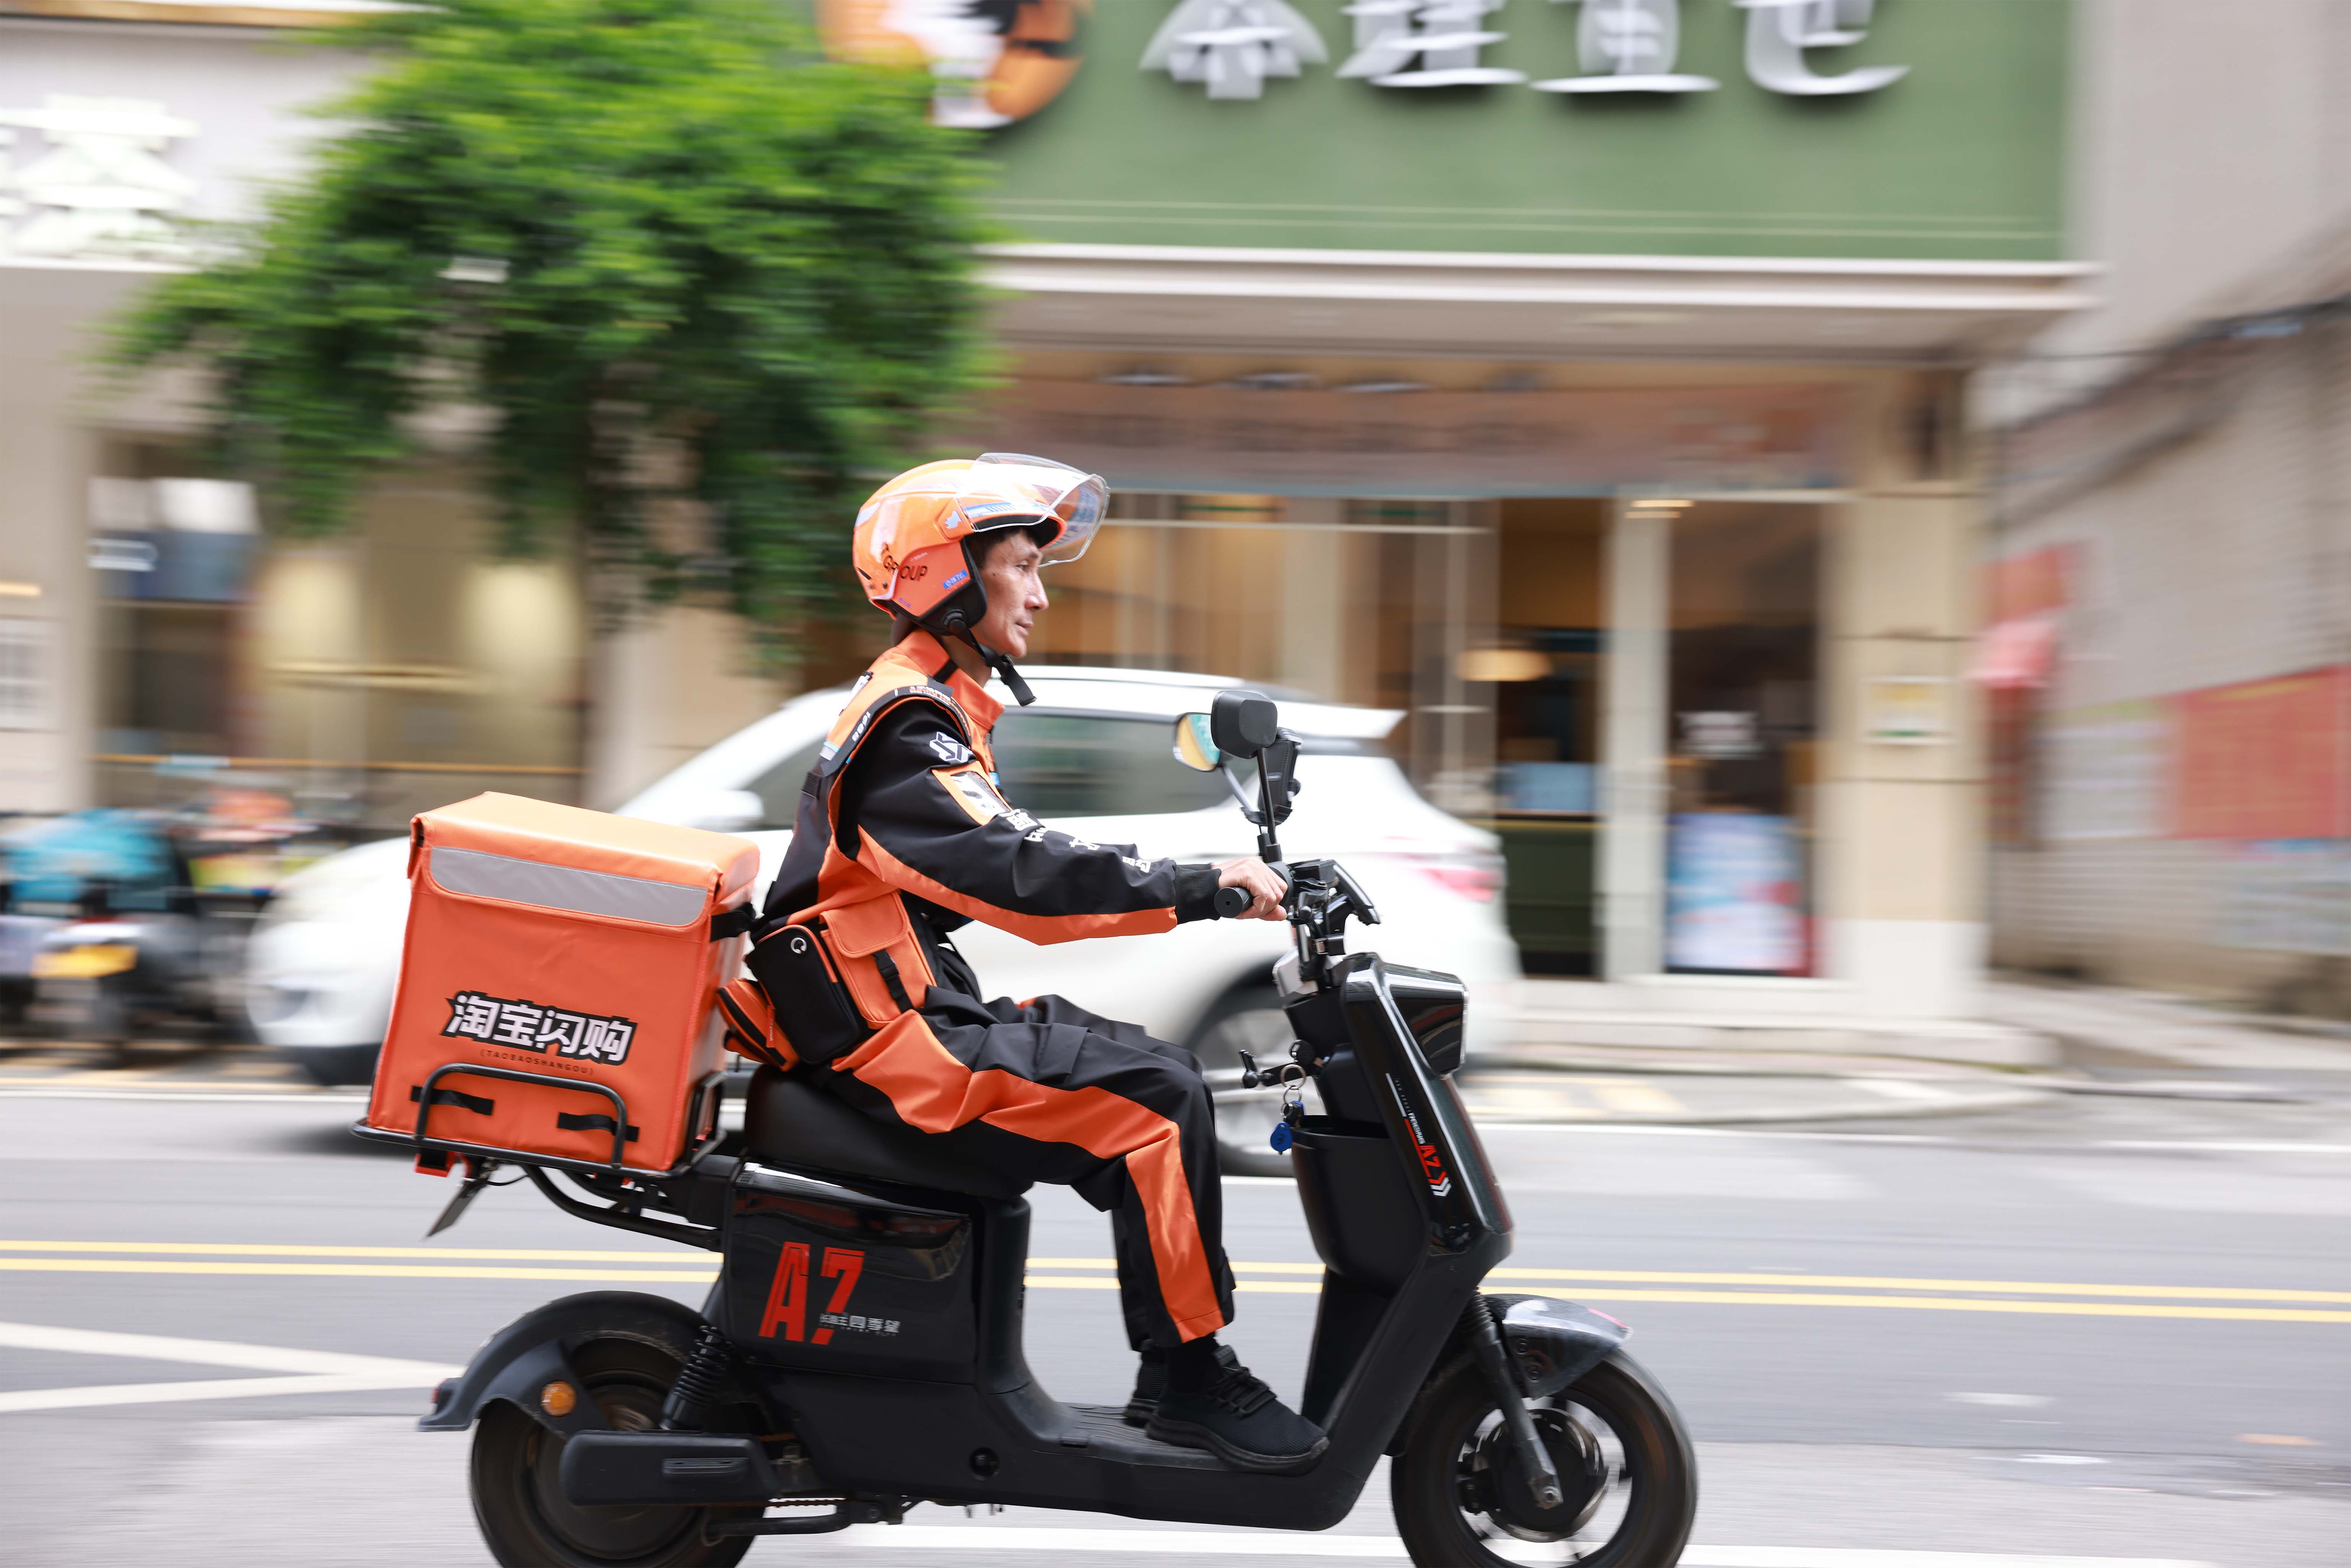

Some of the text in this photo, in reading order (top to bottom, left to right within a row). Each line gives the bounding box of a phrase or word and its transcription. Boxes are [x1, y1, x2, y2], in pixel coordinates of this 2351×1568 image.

[445, 994, 633, 1063] 淘宝闪购
[480, 1048, 594, 1076] (TAOBAOSHANGOU)
[1420, 1145, 1442, 1168] A7
[758, 1241, 865, 1345] A7
